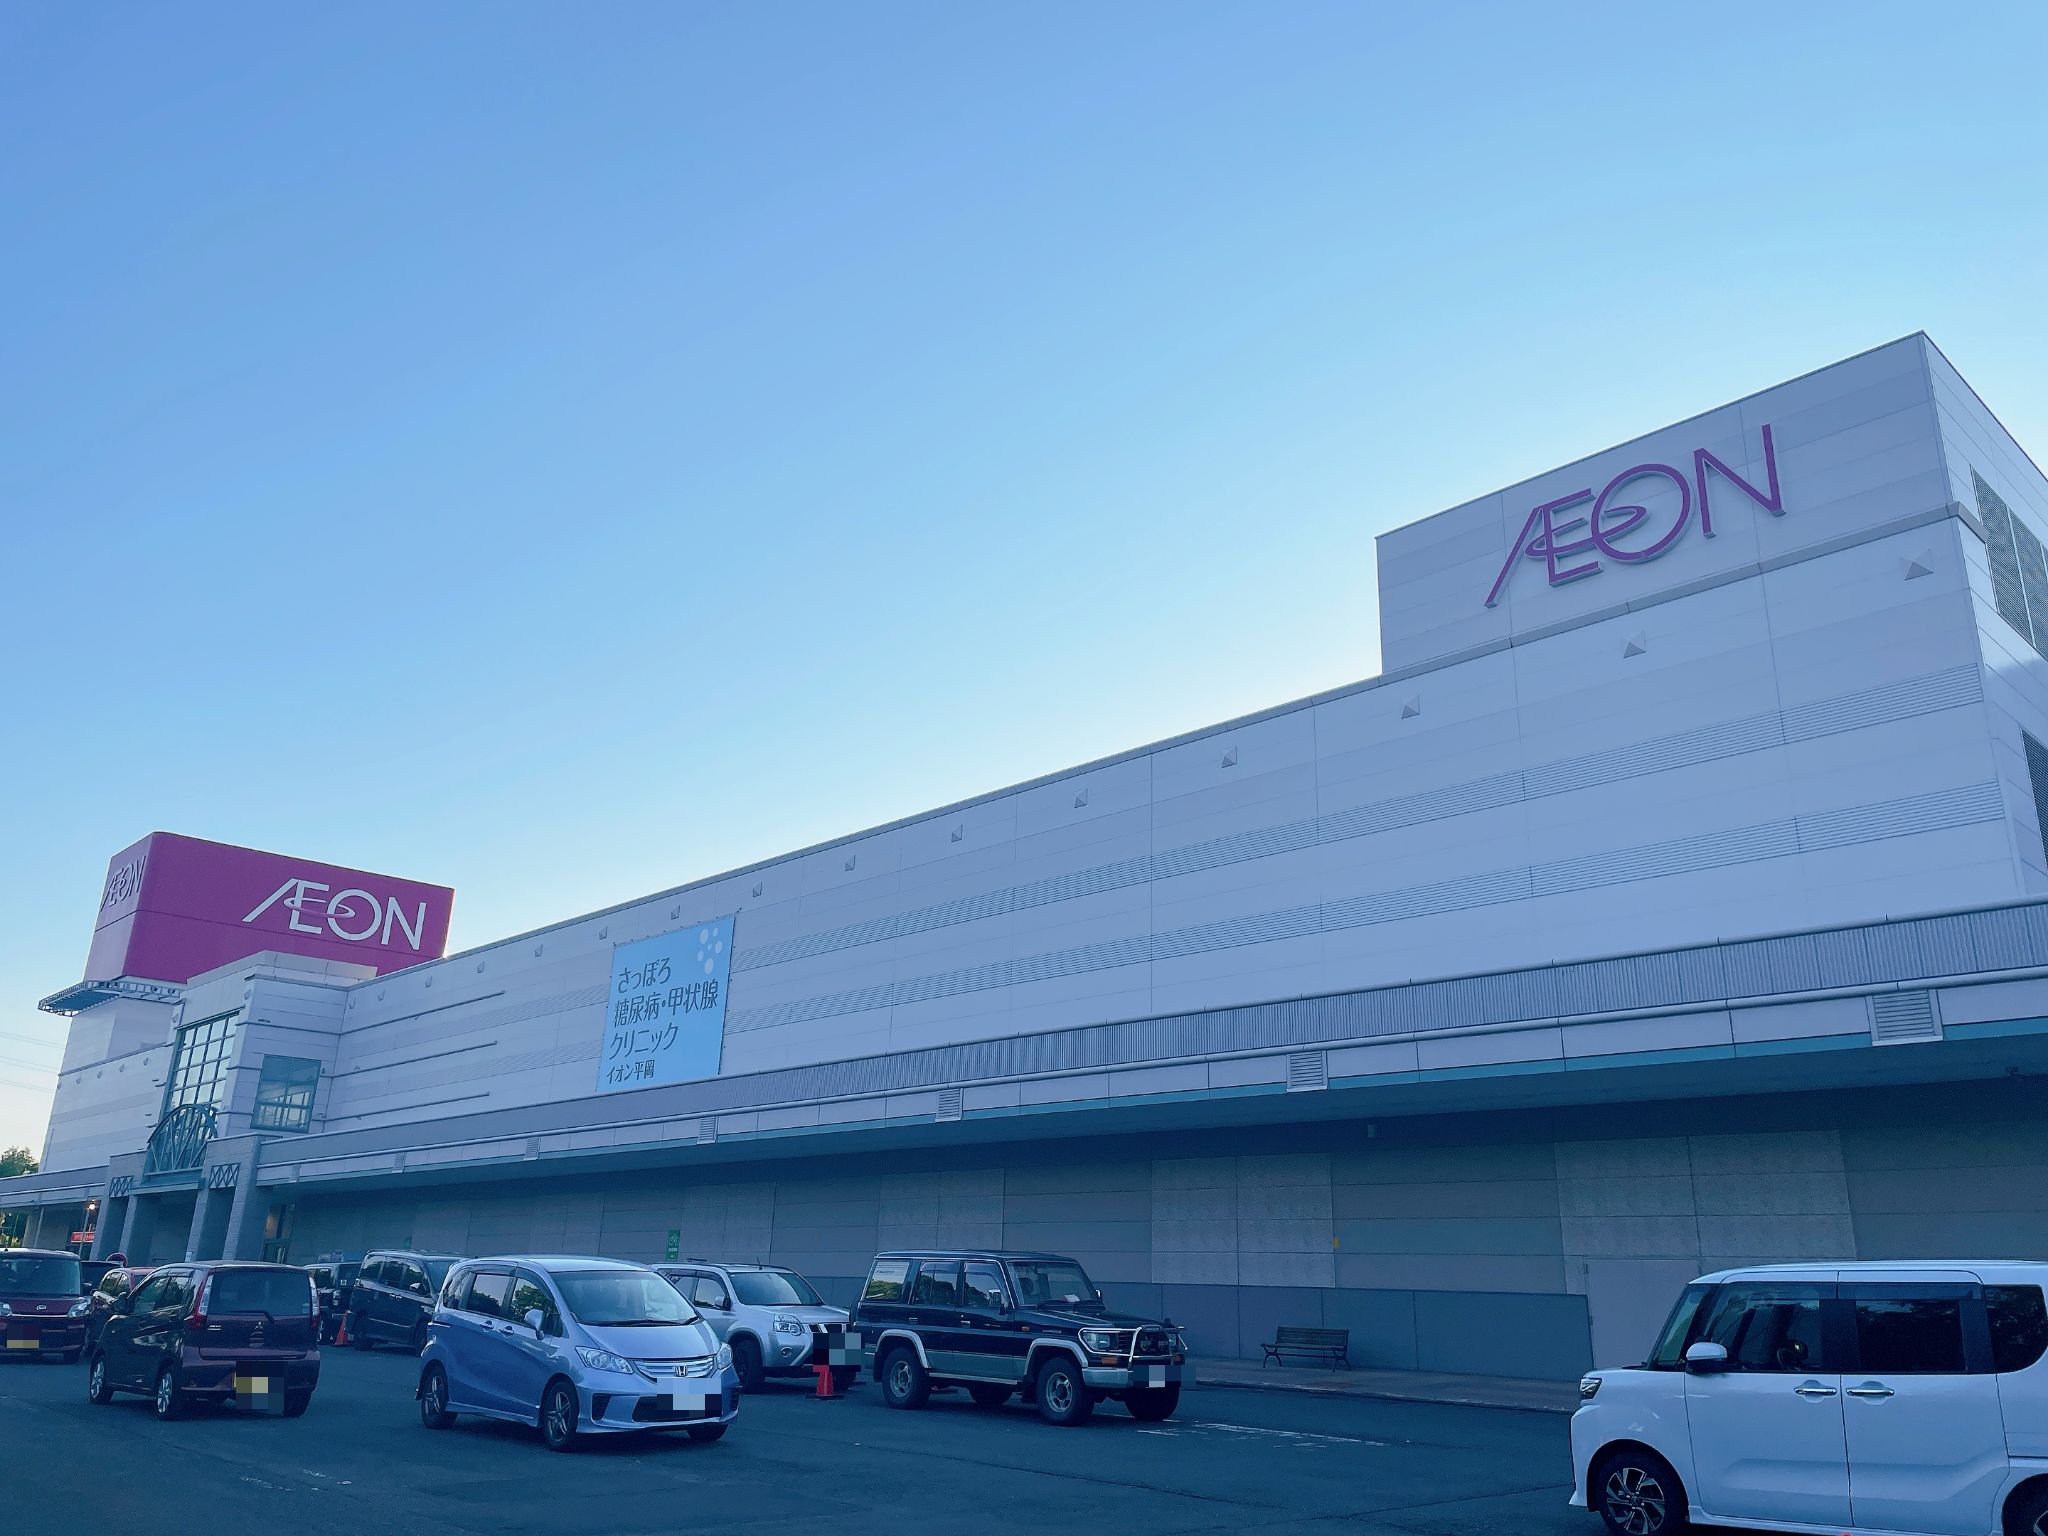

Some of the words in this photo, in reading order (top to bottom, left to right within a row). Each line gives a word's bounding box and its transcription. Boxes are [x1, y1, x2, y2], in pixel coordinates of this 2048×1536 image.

[617, 957, 672, 994] さっぽろ
[613, 978, 719, 1028] 糖尿病・甲状腺
[608, 1022, 679, 1060] クリニック
[606, 1060, 655, 1084] イオン平岡
